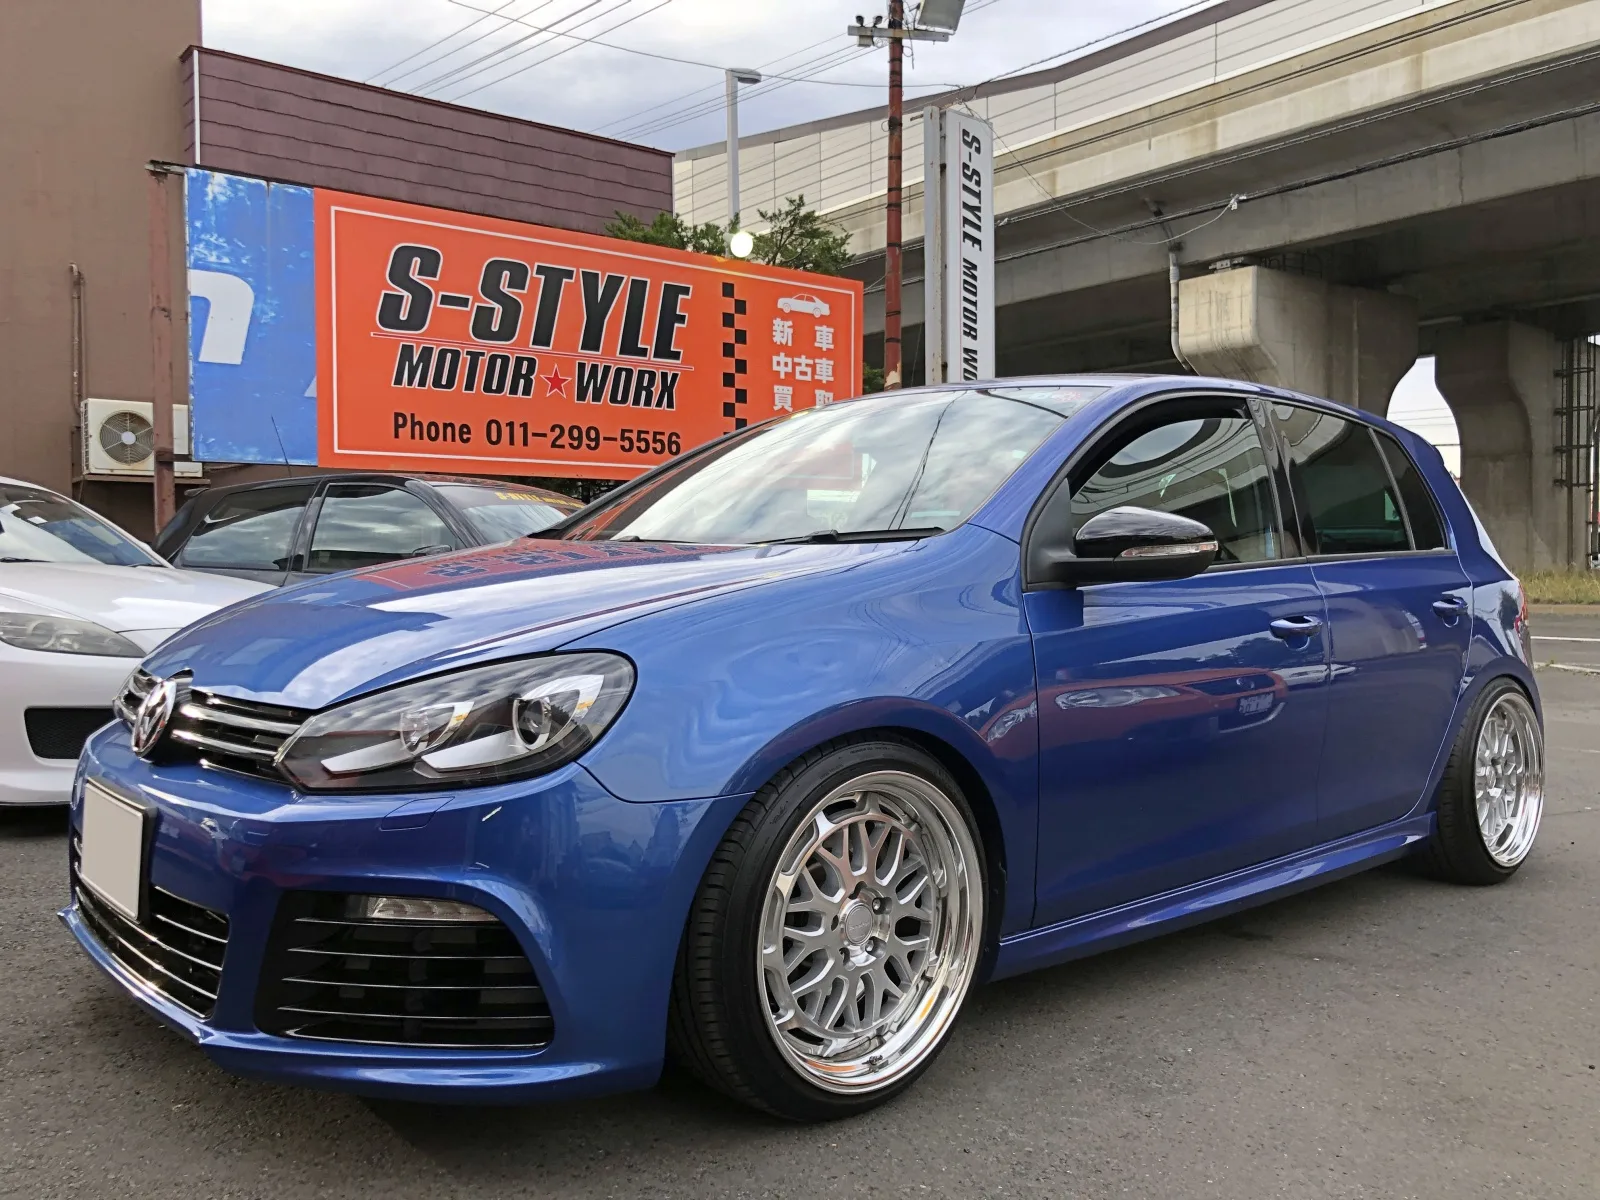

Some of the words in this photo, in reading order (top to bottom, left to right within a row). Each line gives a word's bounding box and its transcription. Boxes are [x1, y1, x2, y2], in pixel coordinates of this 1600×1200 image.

[962, 128, 982, 252] S-STYLE
[376, 243, 693, 362] S-STYLE
[962, 257, 978, 341] MOTOR
[391, 341, 538, 398] MOTOR
[575, 361, 681, 411] WORX
[772, 352, 835, 384] 中古車
[393, 412, 472, 444] Phone
[486, 419, 682, 456] 011-299-5556
